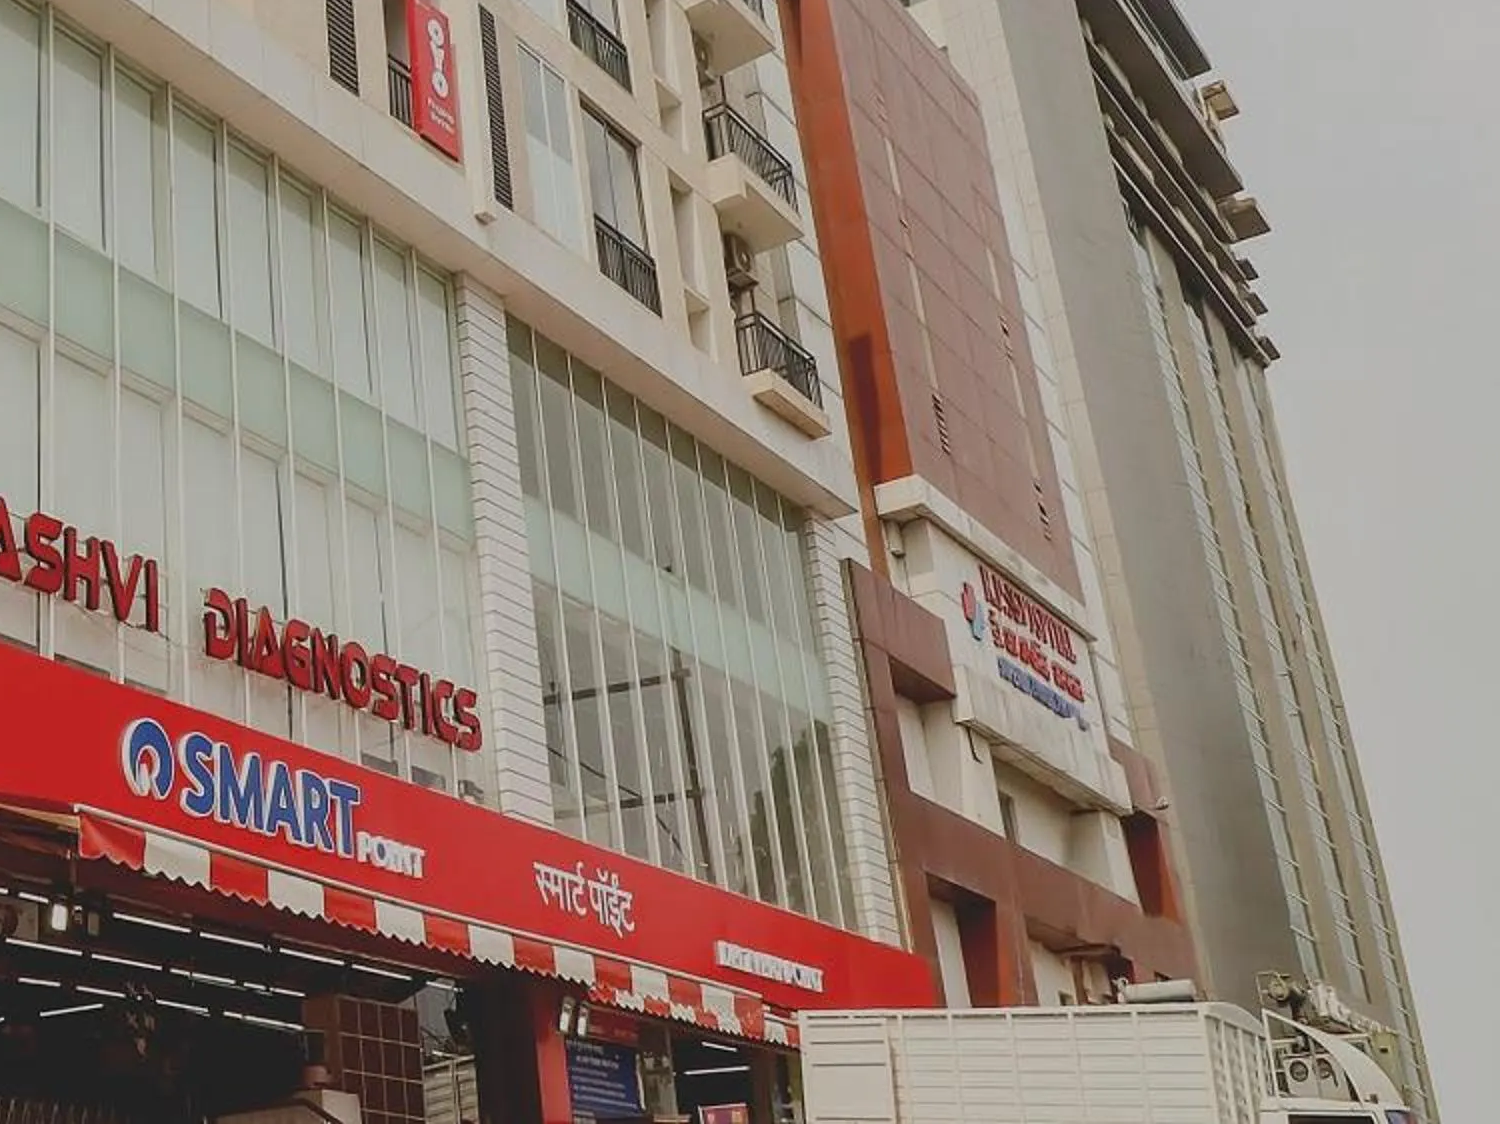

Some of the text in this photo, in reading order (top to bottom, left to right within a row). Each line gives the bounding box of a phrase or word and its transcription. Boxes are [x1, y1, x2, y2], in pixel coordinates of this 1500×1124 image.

[201, 587, 484, 752] DIAGNOSTICS
[179, 731, 426, 879] SMART POINT
[533, 861, 587, 916] स्मार्ट
